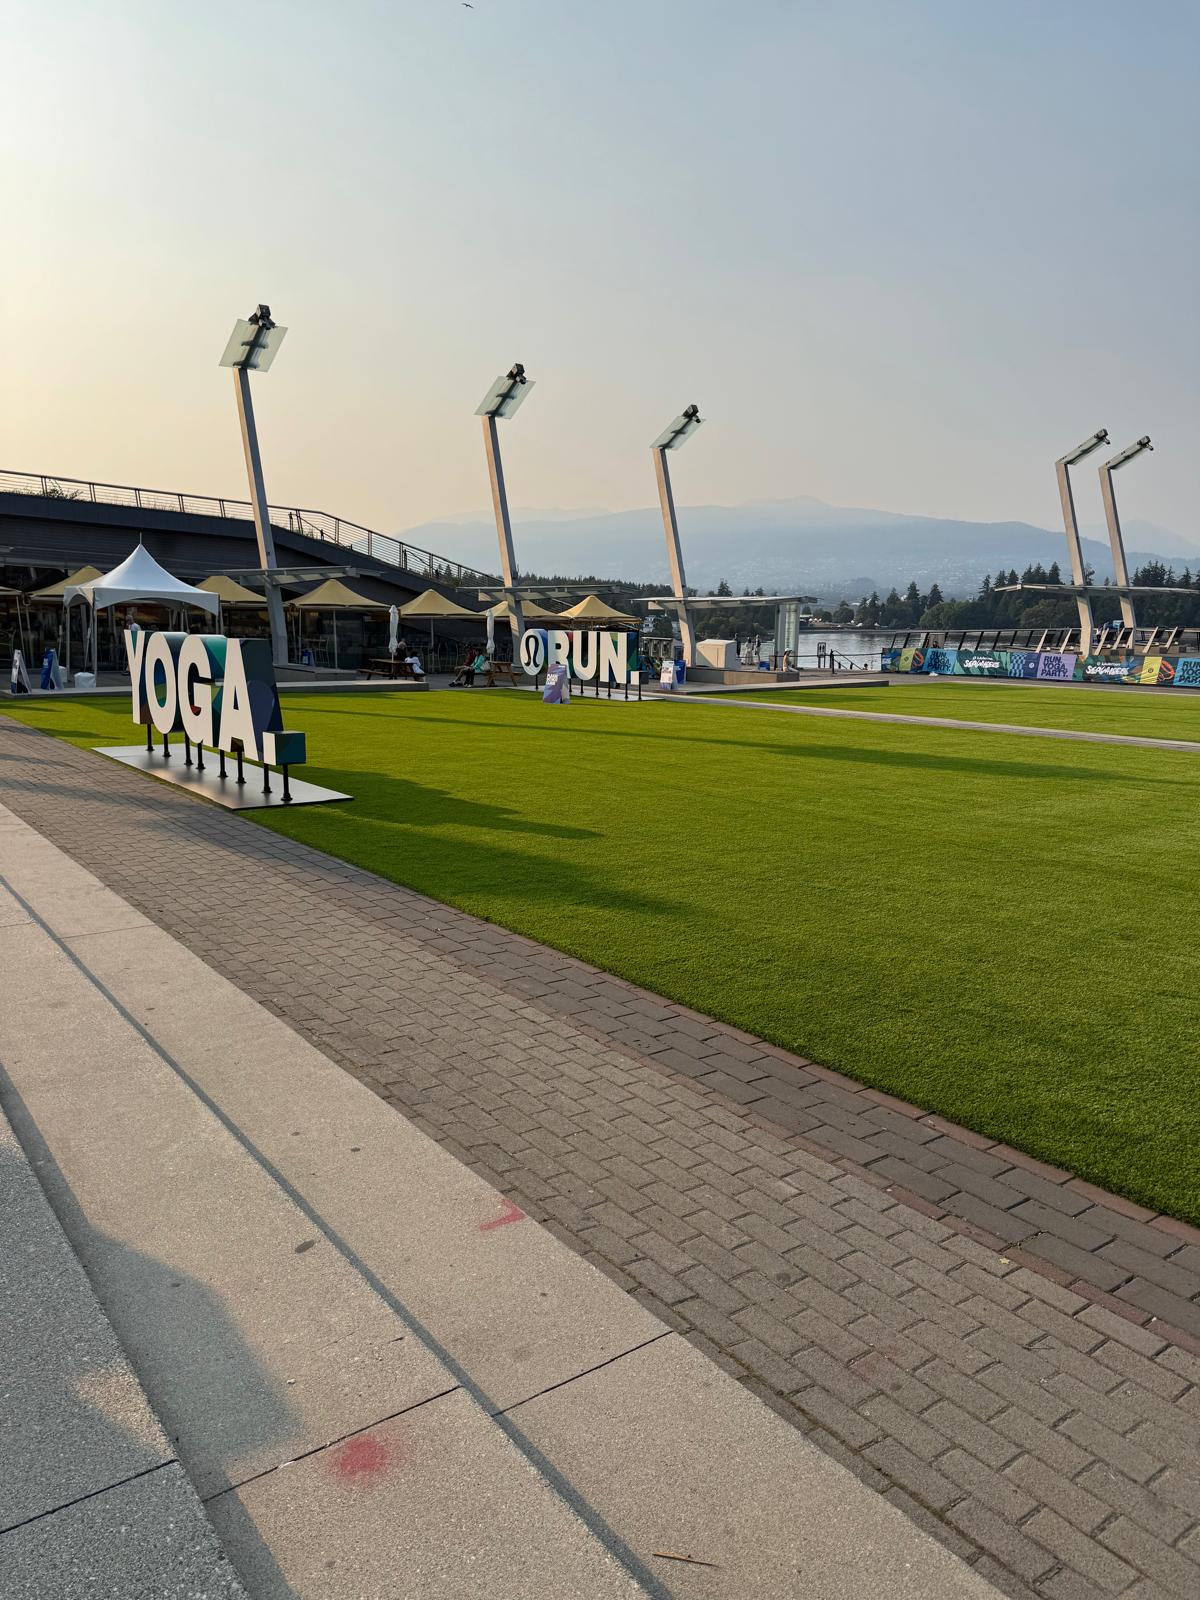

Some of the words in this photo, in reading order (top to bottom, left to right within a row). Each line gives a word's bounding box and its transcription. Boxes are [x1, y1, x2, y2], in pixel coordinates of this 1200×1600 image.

[548, 630, 640, 685] RUN.
[1044, 655, 1063, 663] RUN.
[1043, 662, 1068, 670] YOGA.
[1040, 669, 1068, 678] PARTY.
[124, 629, 277, 766] YOGA.
